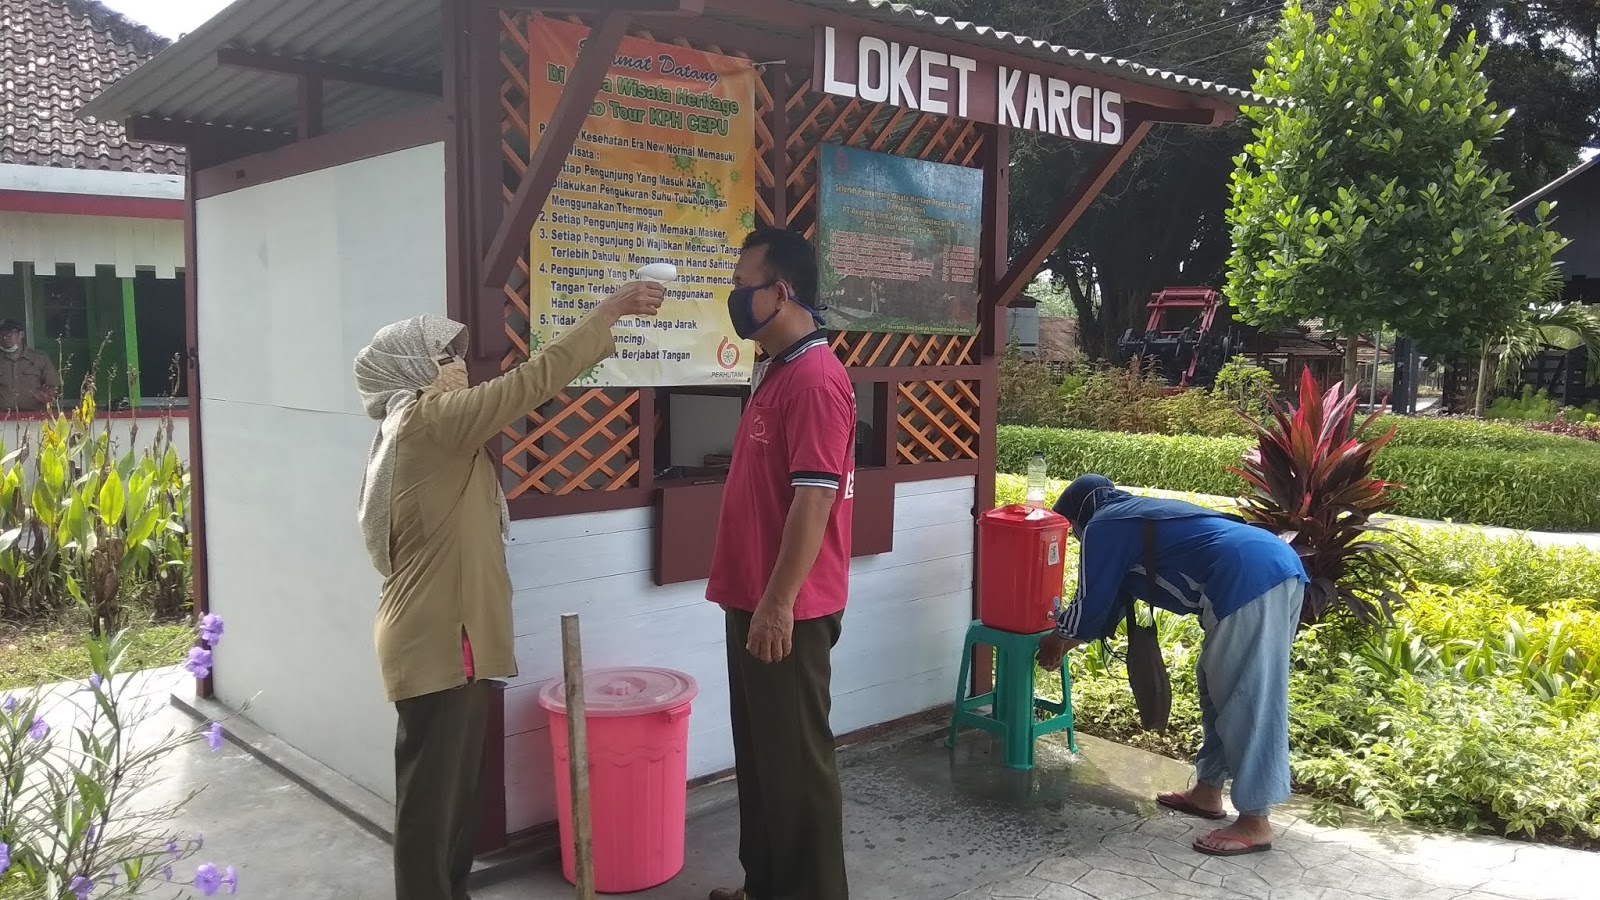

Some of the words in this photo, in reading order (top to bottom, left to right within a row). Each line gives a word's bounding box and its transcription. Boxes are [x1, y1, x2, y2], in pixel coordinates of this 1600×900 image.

[659, 54, 720, 89] Datang
[547, 62, 566, 85] Di
[616, 75, 671, 103] Wisata
[675, 86, 739, 116] Heritage
[824, 26, 977, 117] LOKET
[998, 66, 1122, 144] KARCIS
[608, 99, 646, 123] Tour
[649, 107, 683, 130] KPH
[687, 114, 728, 136] CEPU
[581, 130, 629, 147] Kesehatan
[632, 137, 644, 150] Era
[646, 140, 664, 152] New
[667, 143, 695, 156] Normal
[697, 148, 735, 162] Memasuki
[562, 161, 582, 176] tiap
[584, 164, 634, 183] Pengunjung
[636, 171, 657, 186] Yang
[660, 175, 684, 188] Masuk
[686, 179, 706, 190] Akan
[552, 194, 614, 210] Menggunakan
[616, 203, 663, 218] Thermogun
[600, 183, 648, 198] Pengukuran
[651, 190, 672, 201] Suhu
[674, 193, 698, 204] Tubuh
[699, 195, 727, 209] Dengan
[539, 211, 548, 221] 2.
[551, 212, 581, 227] Setiap
[583, 215, 634, 232] Pengunjung
[636, 221, 657, 234] Wajib
[660, 224, 696, 236] Memakai
[698, 227, 726, 238] Masker
[539, 228, 548, 239] 3.
[551, 229, 581, 244] Setiap
[584, 232, 634, 249] Pengunjung
[636, 237, 645, 248] Di
[647, 238, 682, 251] Wajibkan
[685, 242, 718, 253] Mencuci
[720, 244, 741, 257] Tanga
[551, 246, 589, 259] Terlebih
[592, 249, 620, 262] Dahulu
[628, 252, 683, 267] Menggunakan
[686, 258, 707, 268] Hand
[709, 259, 737, 270] Sanitize
[539, 263, 548, 273] 4.
[551, 263, 604, 279] Pengunjung
[607, 267, 627, 281] Yang
[675, 273, 704, 285] rapkan
[706, 276, 735, 285] mencuc
[551, 281, 585, 294] Tangan
[588, 283, 620, 294] Terlebi
[551, 297, 574, 308] Hand
[540, 314, 549, 325] 5.
[551, 315, 577, 325] Tidak
[635, 318, 650, 328] Dan
[653, 319, 672, 331] Jaga
[675, 319, 698, 329] Jarak
[613, 333, 645, 346] ancing)
[622, 349, 659, 362] Berjabat
[662, 350, 691, 362] Tangan
